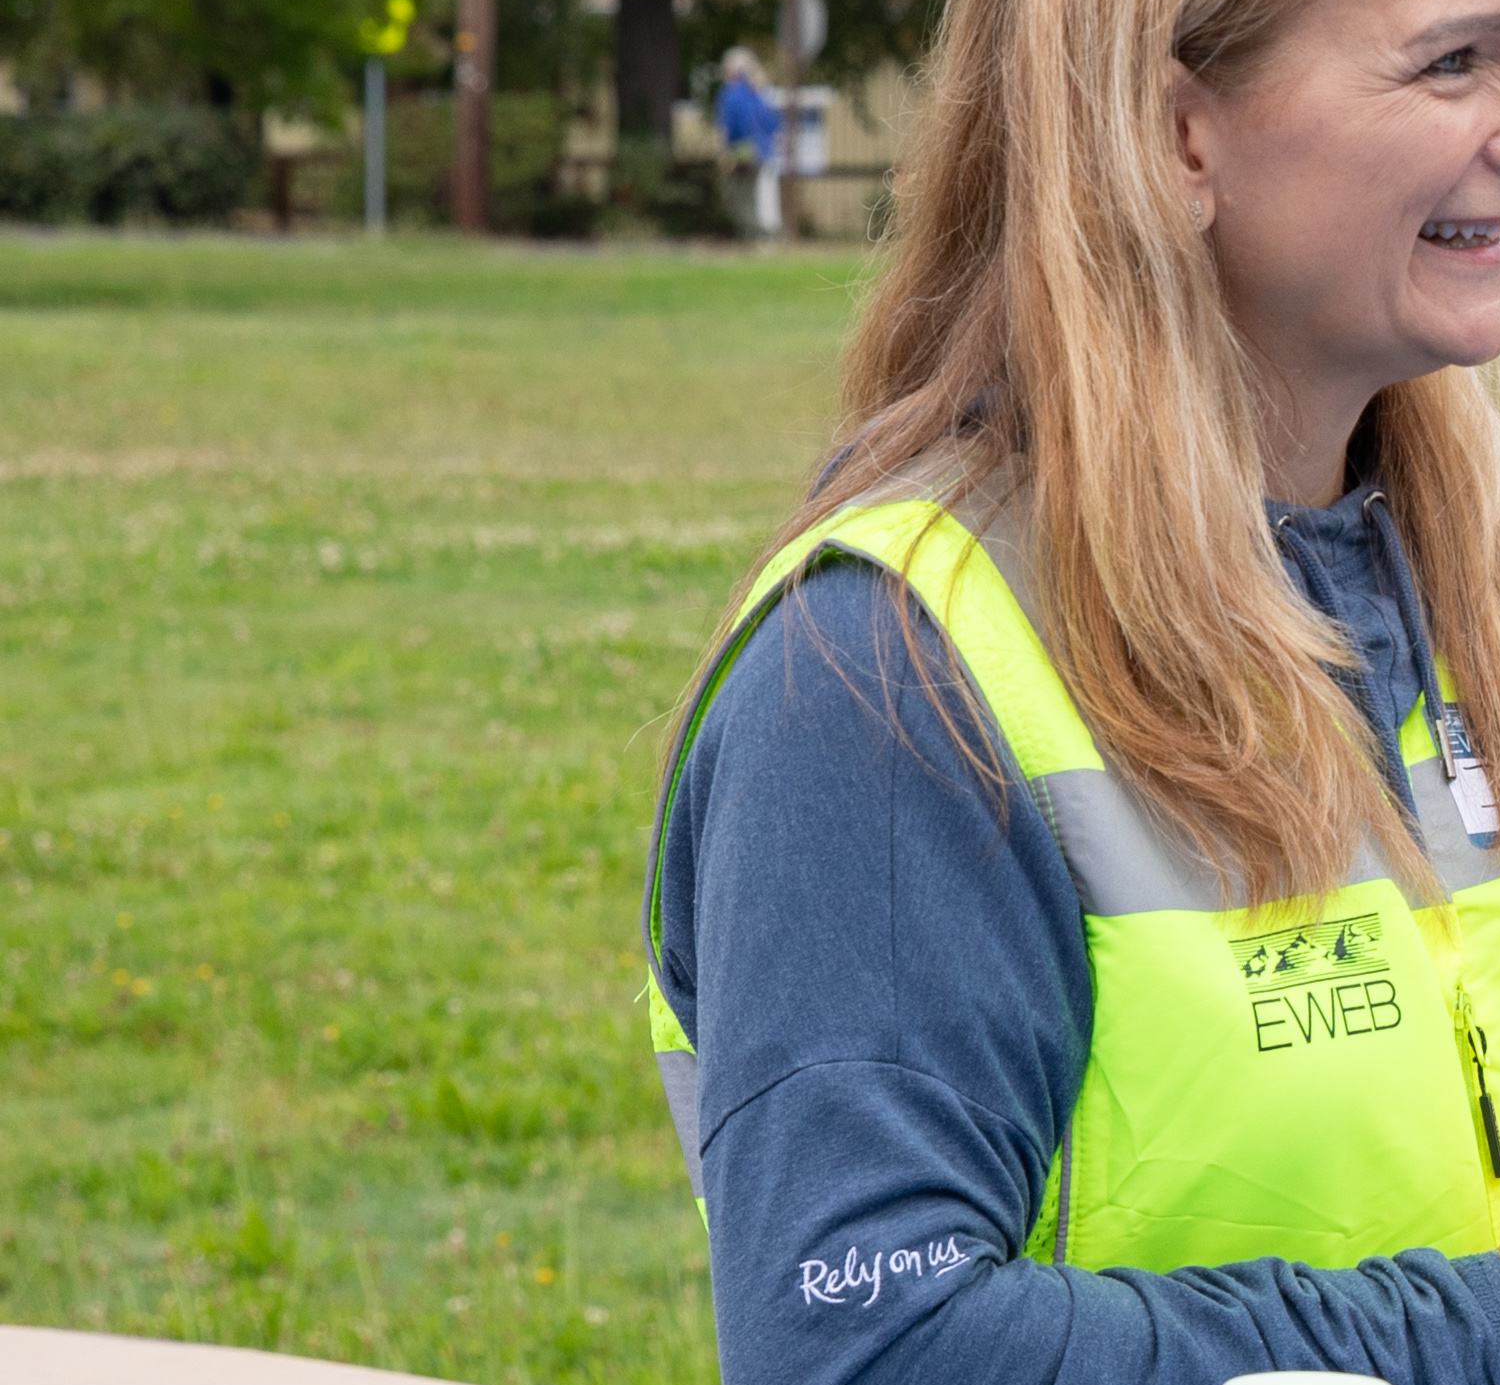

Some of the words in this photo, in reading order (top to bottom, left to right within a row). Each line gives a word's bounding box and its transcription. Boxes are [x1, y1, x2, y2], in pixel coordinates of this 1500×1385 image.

[1251, 978, 1402, 1053] EWEB
[799, 1246, 882, 1308] Rely
[890, 1249, 922, 1277] on
